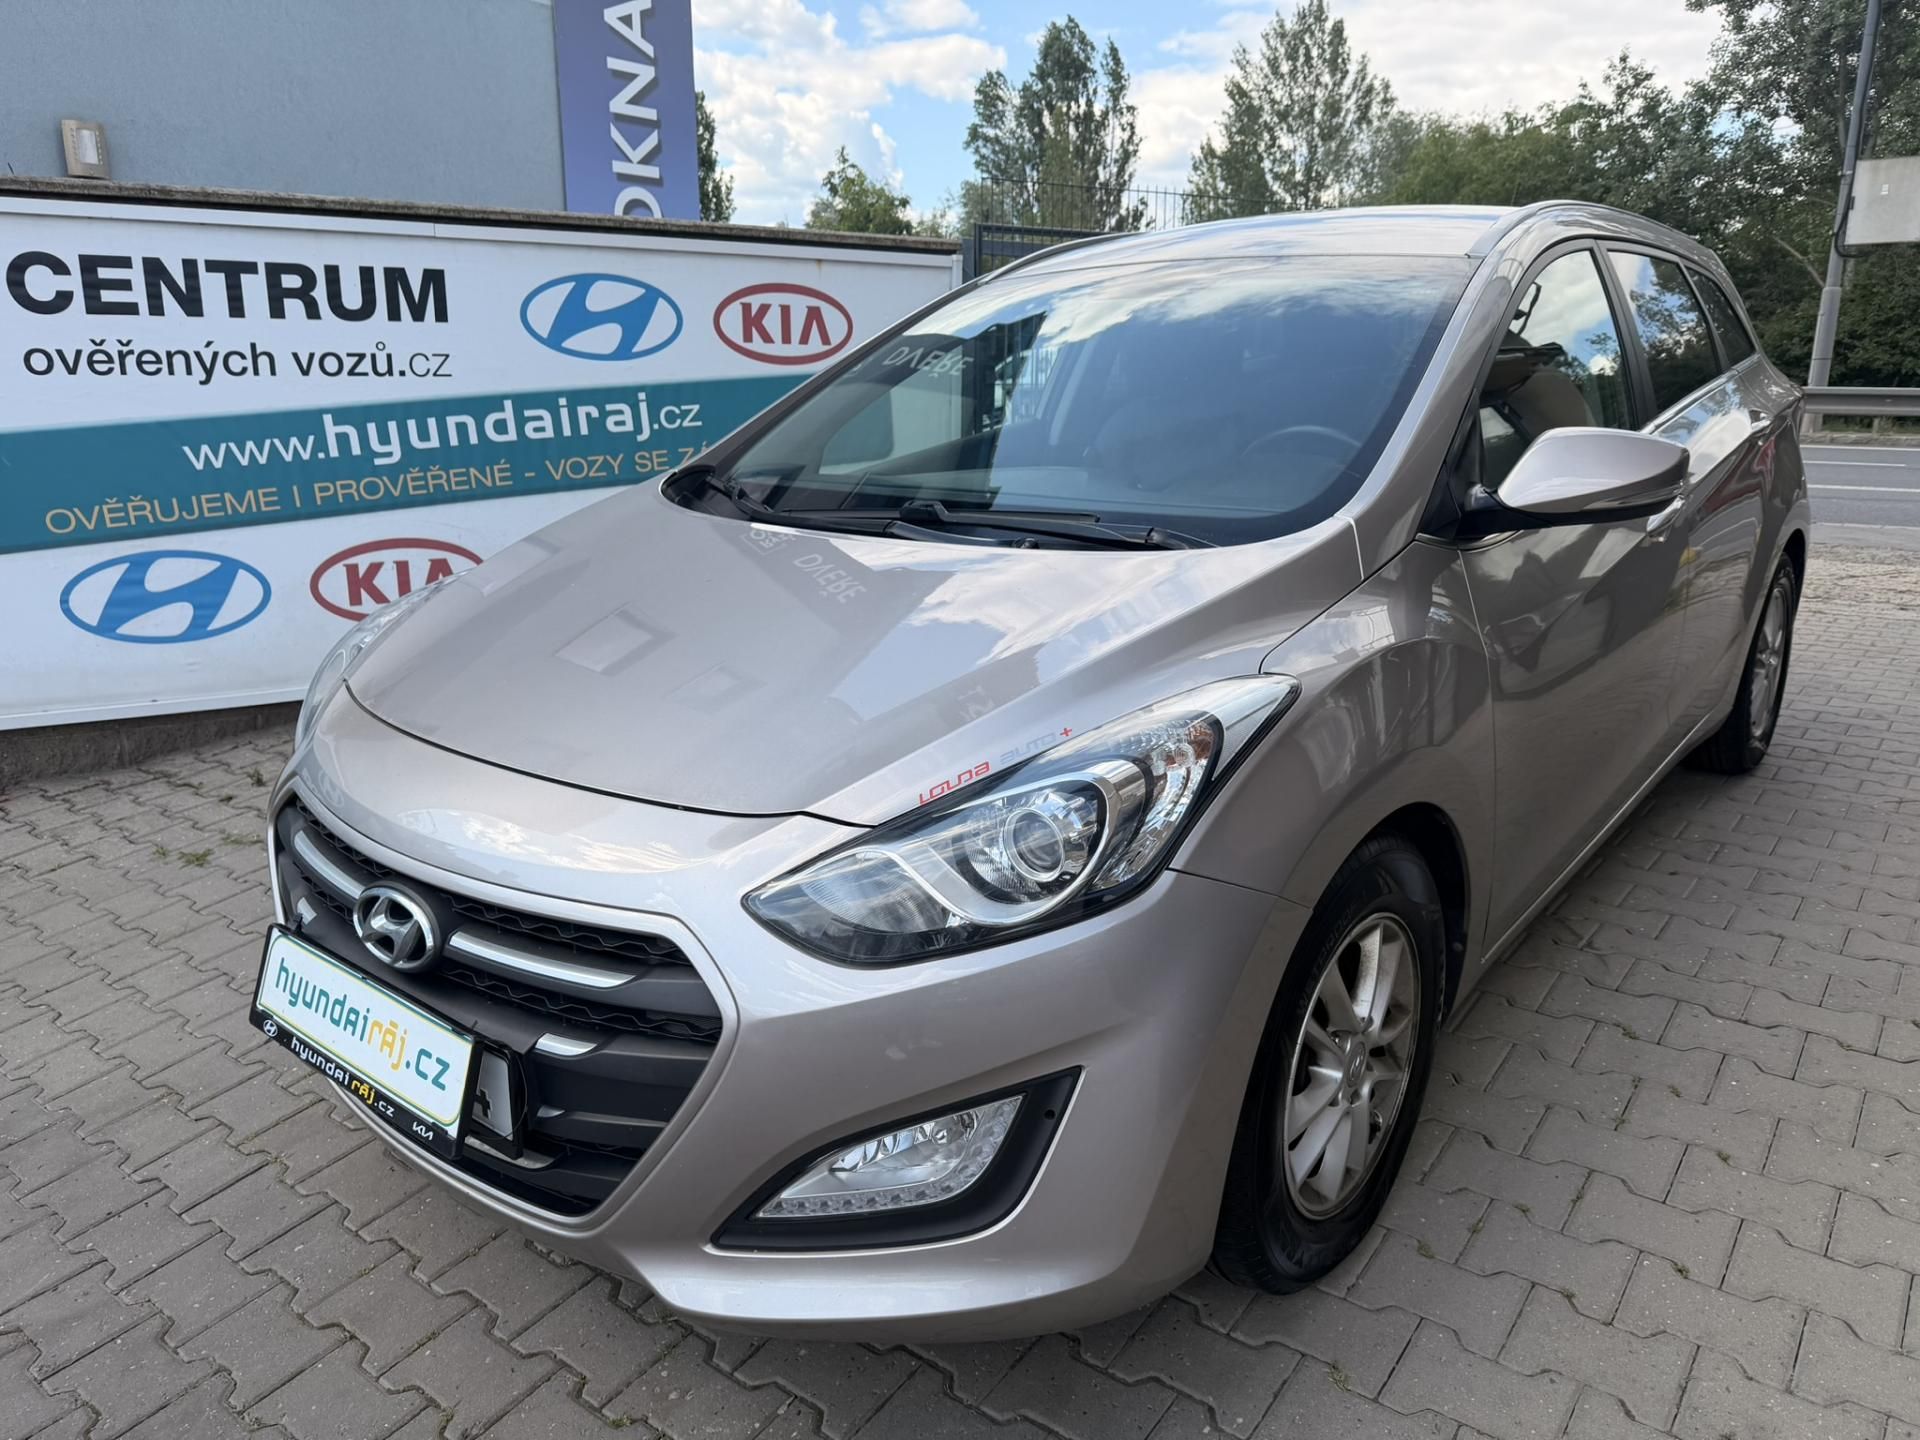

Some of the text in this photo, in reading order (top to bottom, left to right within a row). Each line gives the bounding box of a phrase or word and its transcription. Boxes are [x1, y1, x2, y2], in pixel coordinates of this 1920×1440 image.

[5, 251, 449, 323] CENTRUM
[740, 302, 832, 346] KIA
[23, 339, 453, 385] ověřených vozů.cz
[182, 392, 702, 471] www.hyundairaj.cz
[45, 495, 281, 534] OVĚŘUJEME
[313, 459, 513, 506] PROVĚŘENÉ
[545, 454, 624, 481] VOZY
[634, 450, 670, 472] SE
